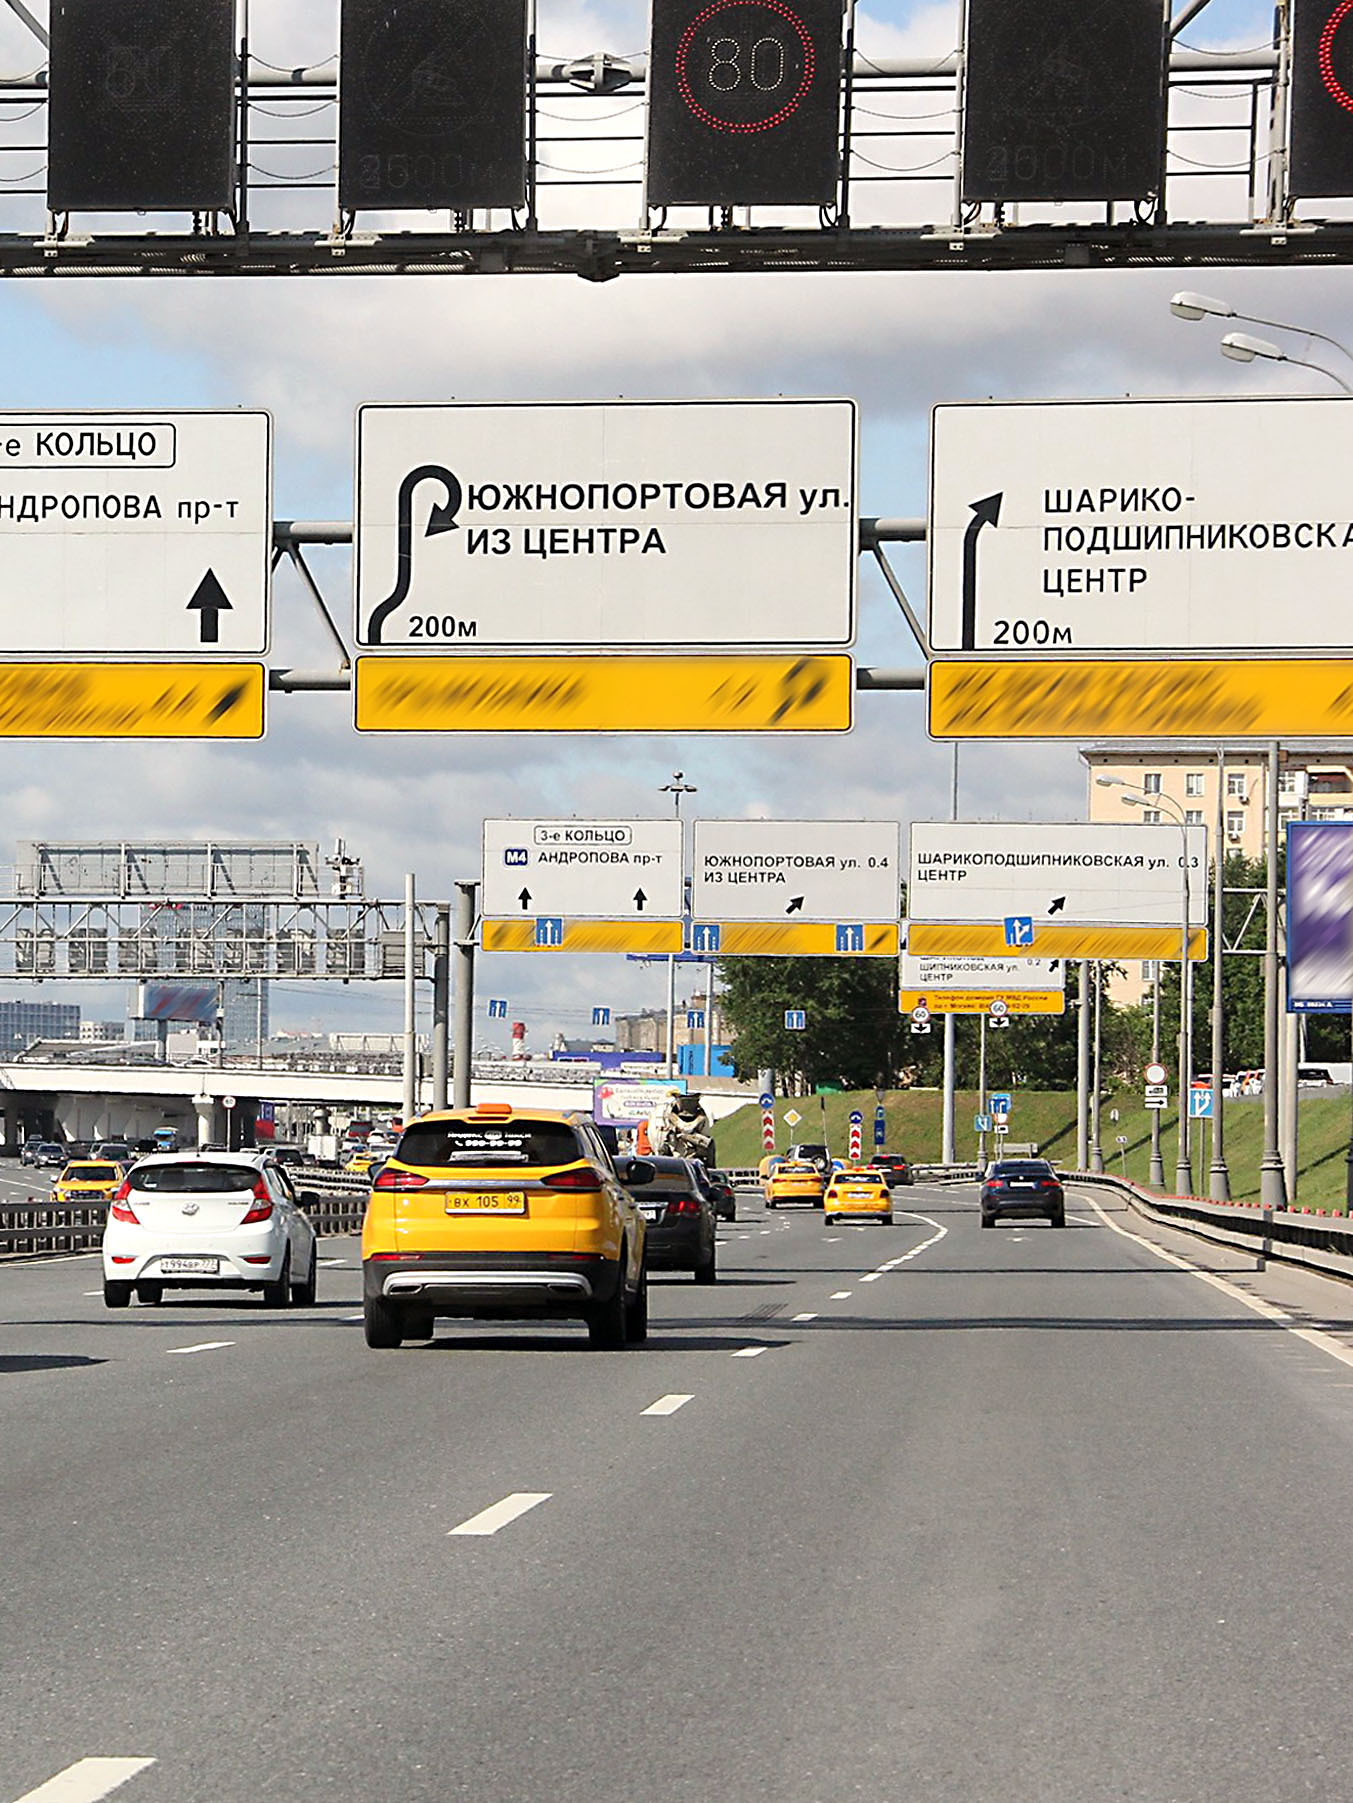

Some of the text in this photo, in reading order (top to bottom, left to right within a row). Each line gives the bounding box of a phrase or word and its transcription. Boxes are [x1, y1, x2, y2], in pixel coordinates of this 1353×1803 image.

[708, 38, 784, 91] 80
[35, 431, 157, 461] КОЛЬЦО
[468, 482, 850, 516] ЮЖНОПОРТОВАЯ ул.
[1044, 486, 1195, 513] ШАРИКО-
[178, 500, 239, 525] пр-т
[467, 527, 667, 558] ИЗ ЦЕНТРА
[1043, 567, 1147, 598] ЦЕНТР
[408, 615, 477, 638] 200м
[993, 620, 1072, 645] 200м
[540, 829, 626, 843] 3-е КОЛЬЦО
[506, 851, 527, 864] М4
[538, 851, 662, 866] АНДРОПОВА пр-т
[704, 855, 889, 871] ЮЖНОПОРТОВАЯ ул. 0.4
[918, 853, 1144, 867] ШАРИКОПОДШИПНИКОВСКАЯ
[1148, 858, 1170, 871] ул.
[704, 871, 786, 885] ИЗ ЦЕНТРА
[918, 869, 967, 883] ЦЕНТР
[919, 962, 1004, 973] ШИПНИКОВСКАЯ
[919, 973, 954, 983] ЦЕНТР
[476, 1195, 499, 1208] 105
